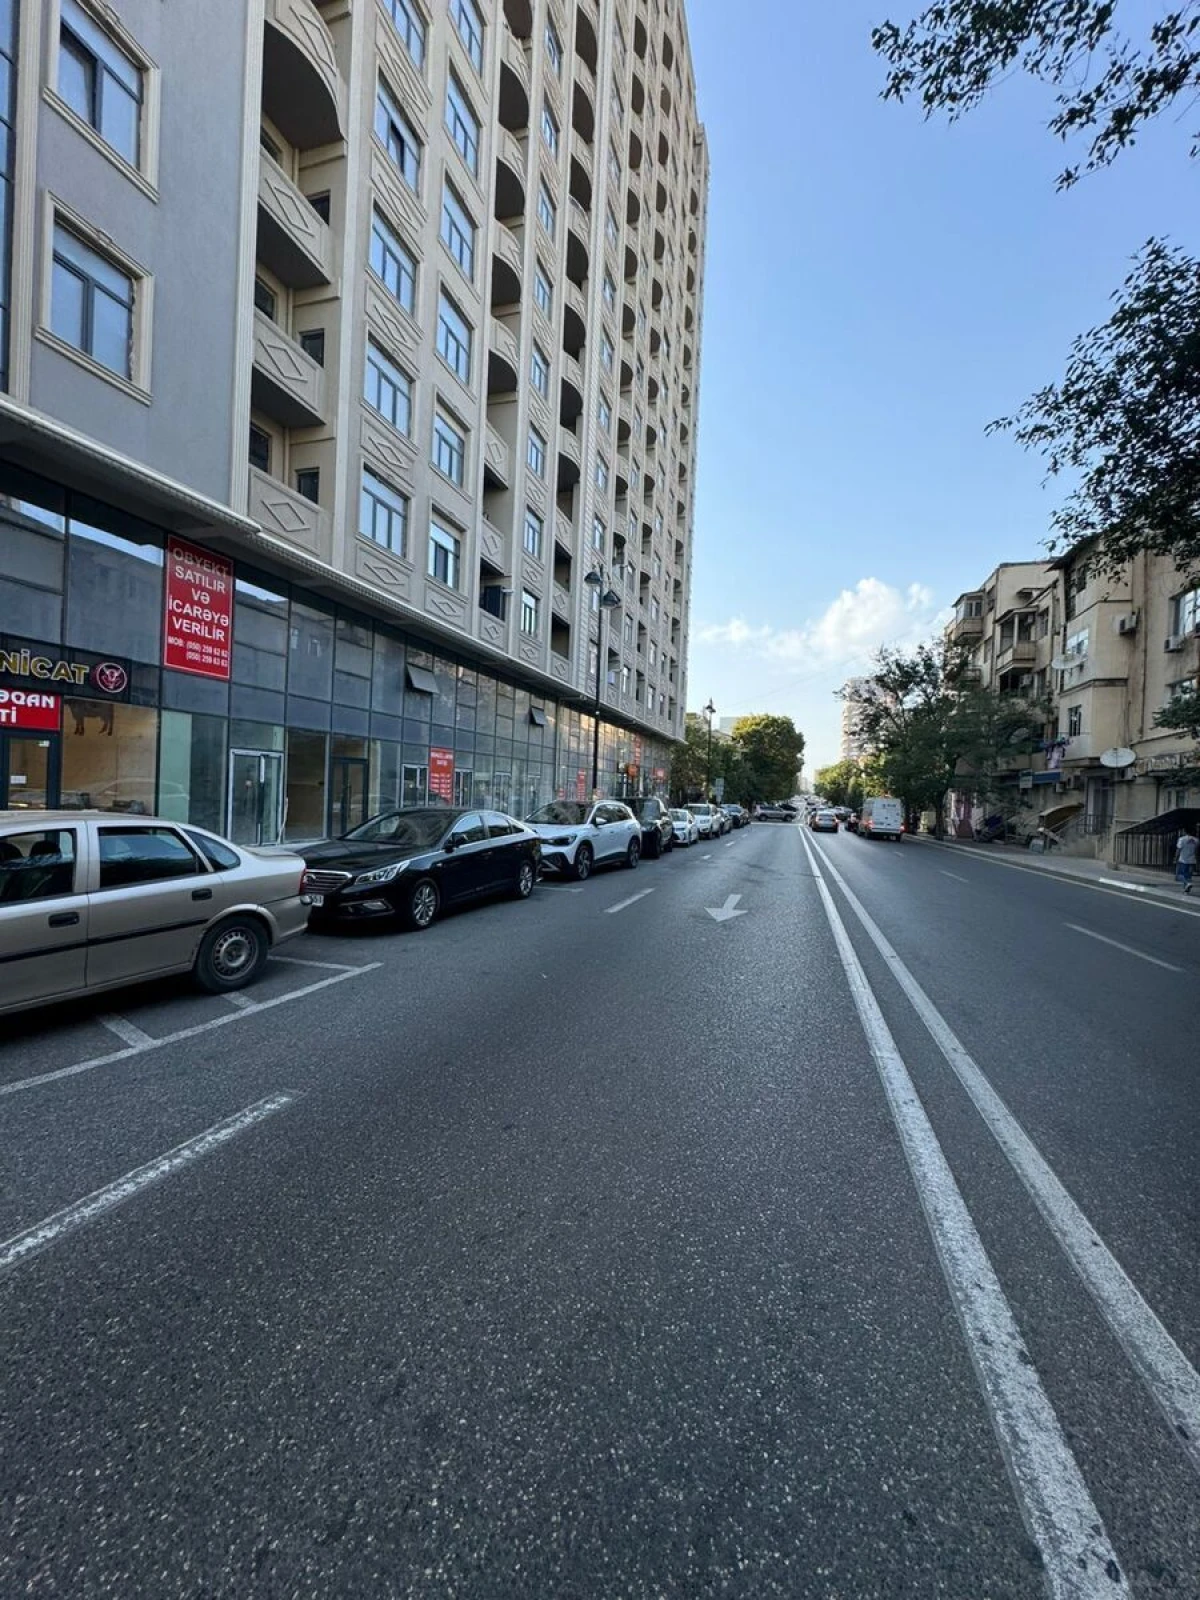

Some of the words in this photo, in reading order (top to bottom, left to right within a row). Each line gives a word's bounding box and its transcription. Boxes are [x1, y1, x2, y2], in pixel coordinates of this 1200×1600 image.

[173, 548, 228, 578] OBYEKT
[175, 565, 225, 594] SATILIR
[191, 587, 210, 604] VƏ
[168, 594, 229, 627] İCARƏYƏ
[172, 615, 225, 642] VERİLİR
